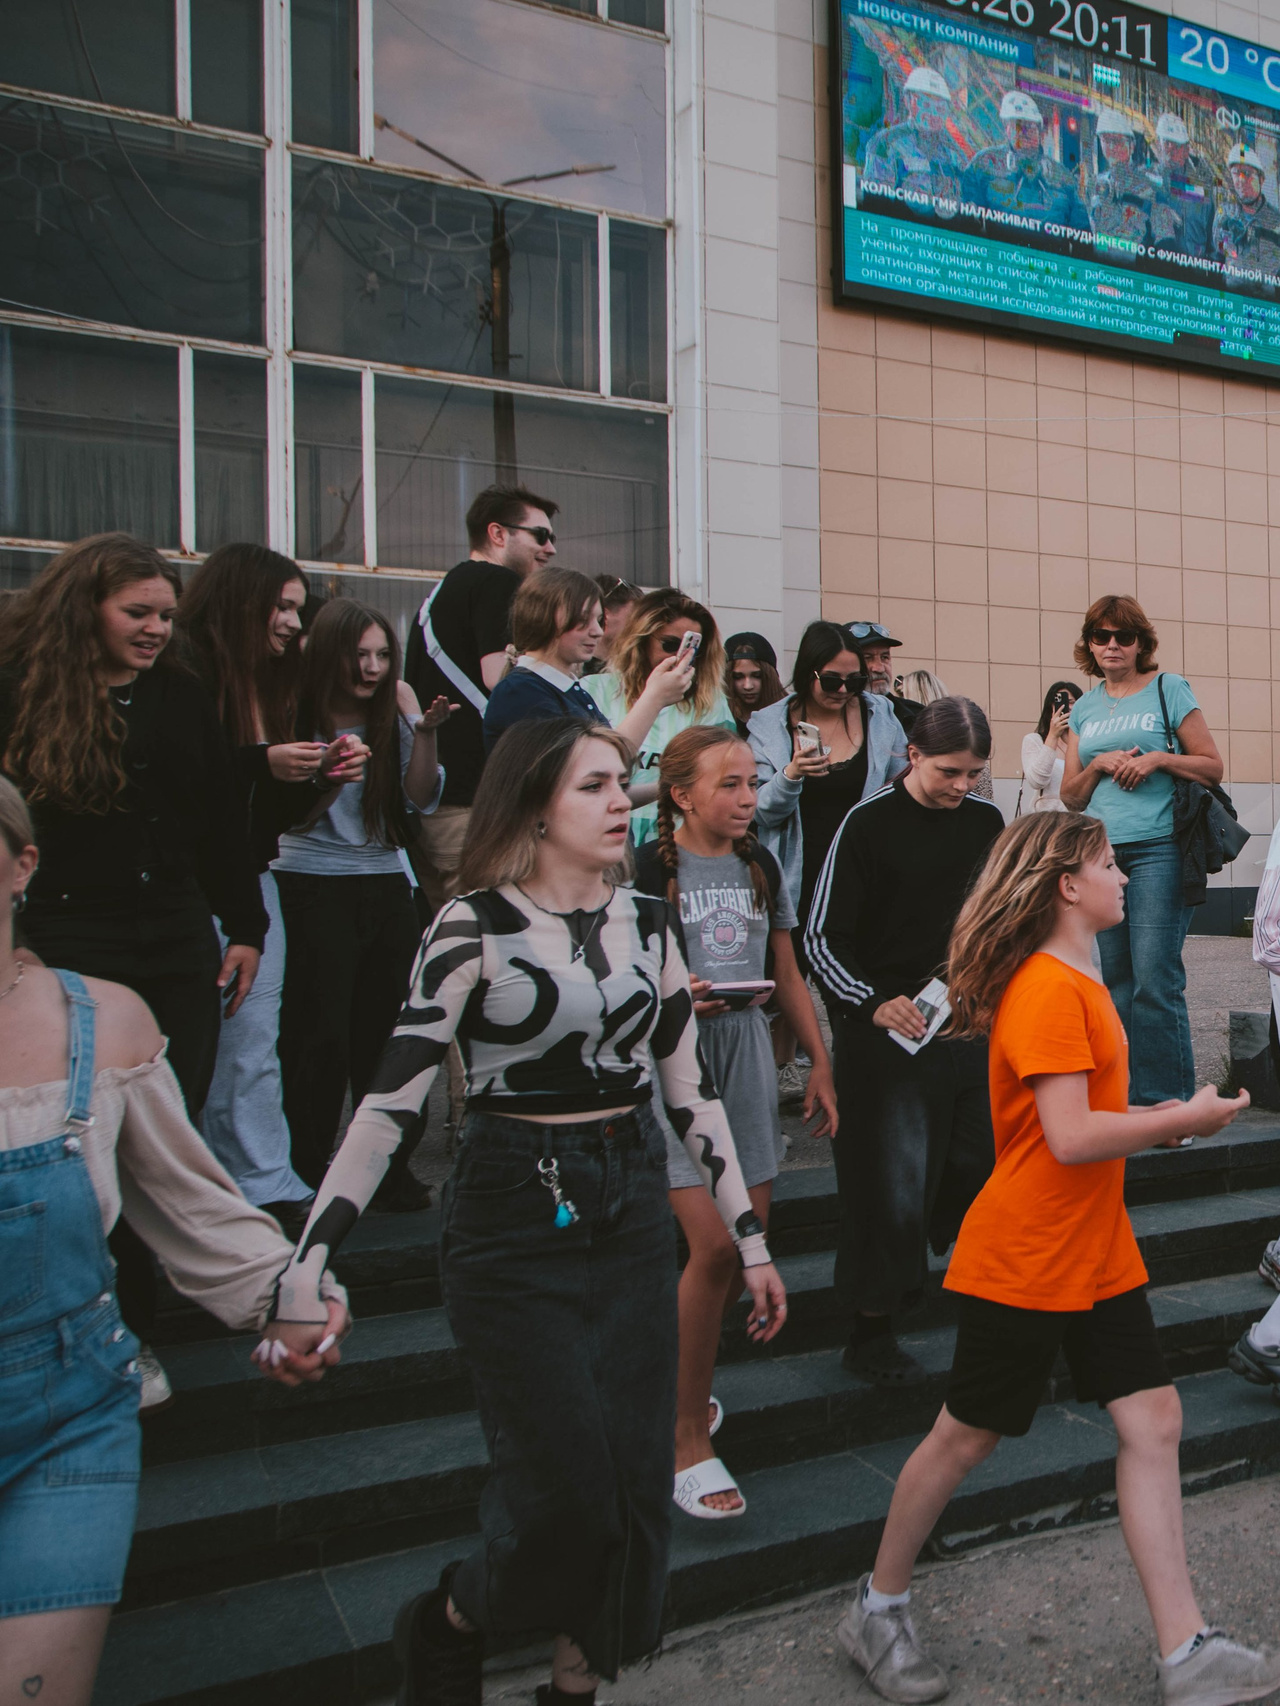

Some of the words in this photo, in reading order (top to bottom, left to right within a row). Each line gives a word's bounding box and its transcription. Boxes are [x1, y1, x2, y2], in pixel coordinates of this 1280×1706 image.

[857, 0, 931, 31] НОВОСТИ
[935, 22, 1019, 58] КОМПАНИИ
[1049, 0, 1157, 67] 20:11
[1180, 27, 1229, 75] 20
[860, 179, 929, 205] КОЛЬСКАЯ
[932, 195, 958, 211] ГМК
[960, 201, 1042, 231] НАЛАЖИВАЕТ
[1044, 223, 1146, 256] СОТРУДНИЧЕСТВО
[1147, 246, 1156, 258] С
[1157, 248, 1263, 283] ФУНДАМЕНТАЛЬНОЙ
[861, 218, 878, 233] На
[890, 226, 988, 257] промплощадке
[1085, 269, 1134, 288] рабочим
[1143, 281, 1189, 300] визитом
[1198, 293, 1234, 310] группа
[861, 251, 941, 276] платиновых
[948, 269, 1012, 291] металлов.
[1018, 281, 1049, 299] Цель
[1069, 293, 1135, 316] знакомство
[1152, 310, 1227, 335] технологиями
[1232, 326, 1263, 345] КГМК,
[861, 267, 912, 286] опытом
[916, 278, 998, 304] организации
[1001, 295, 1087, 320] исследований
[1089, 313, 1097, 323] и
[1100, 316, 1175, 340] интерпретац
[918, 248, 982, 271] входящих
[986, 262, 994, 272] в
[997, 264, 1039, 284] список
[1043, 274, 1088, 293] лучших
[1091, 284, 1169, 310] специалистов
[1172, 302, 1211, 319] страны
[1214, 311, 1221, 320] в
[1223, 309, 1266, 330] области
